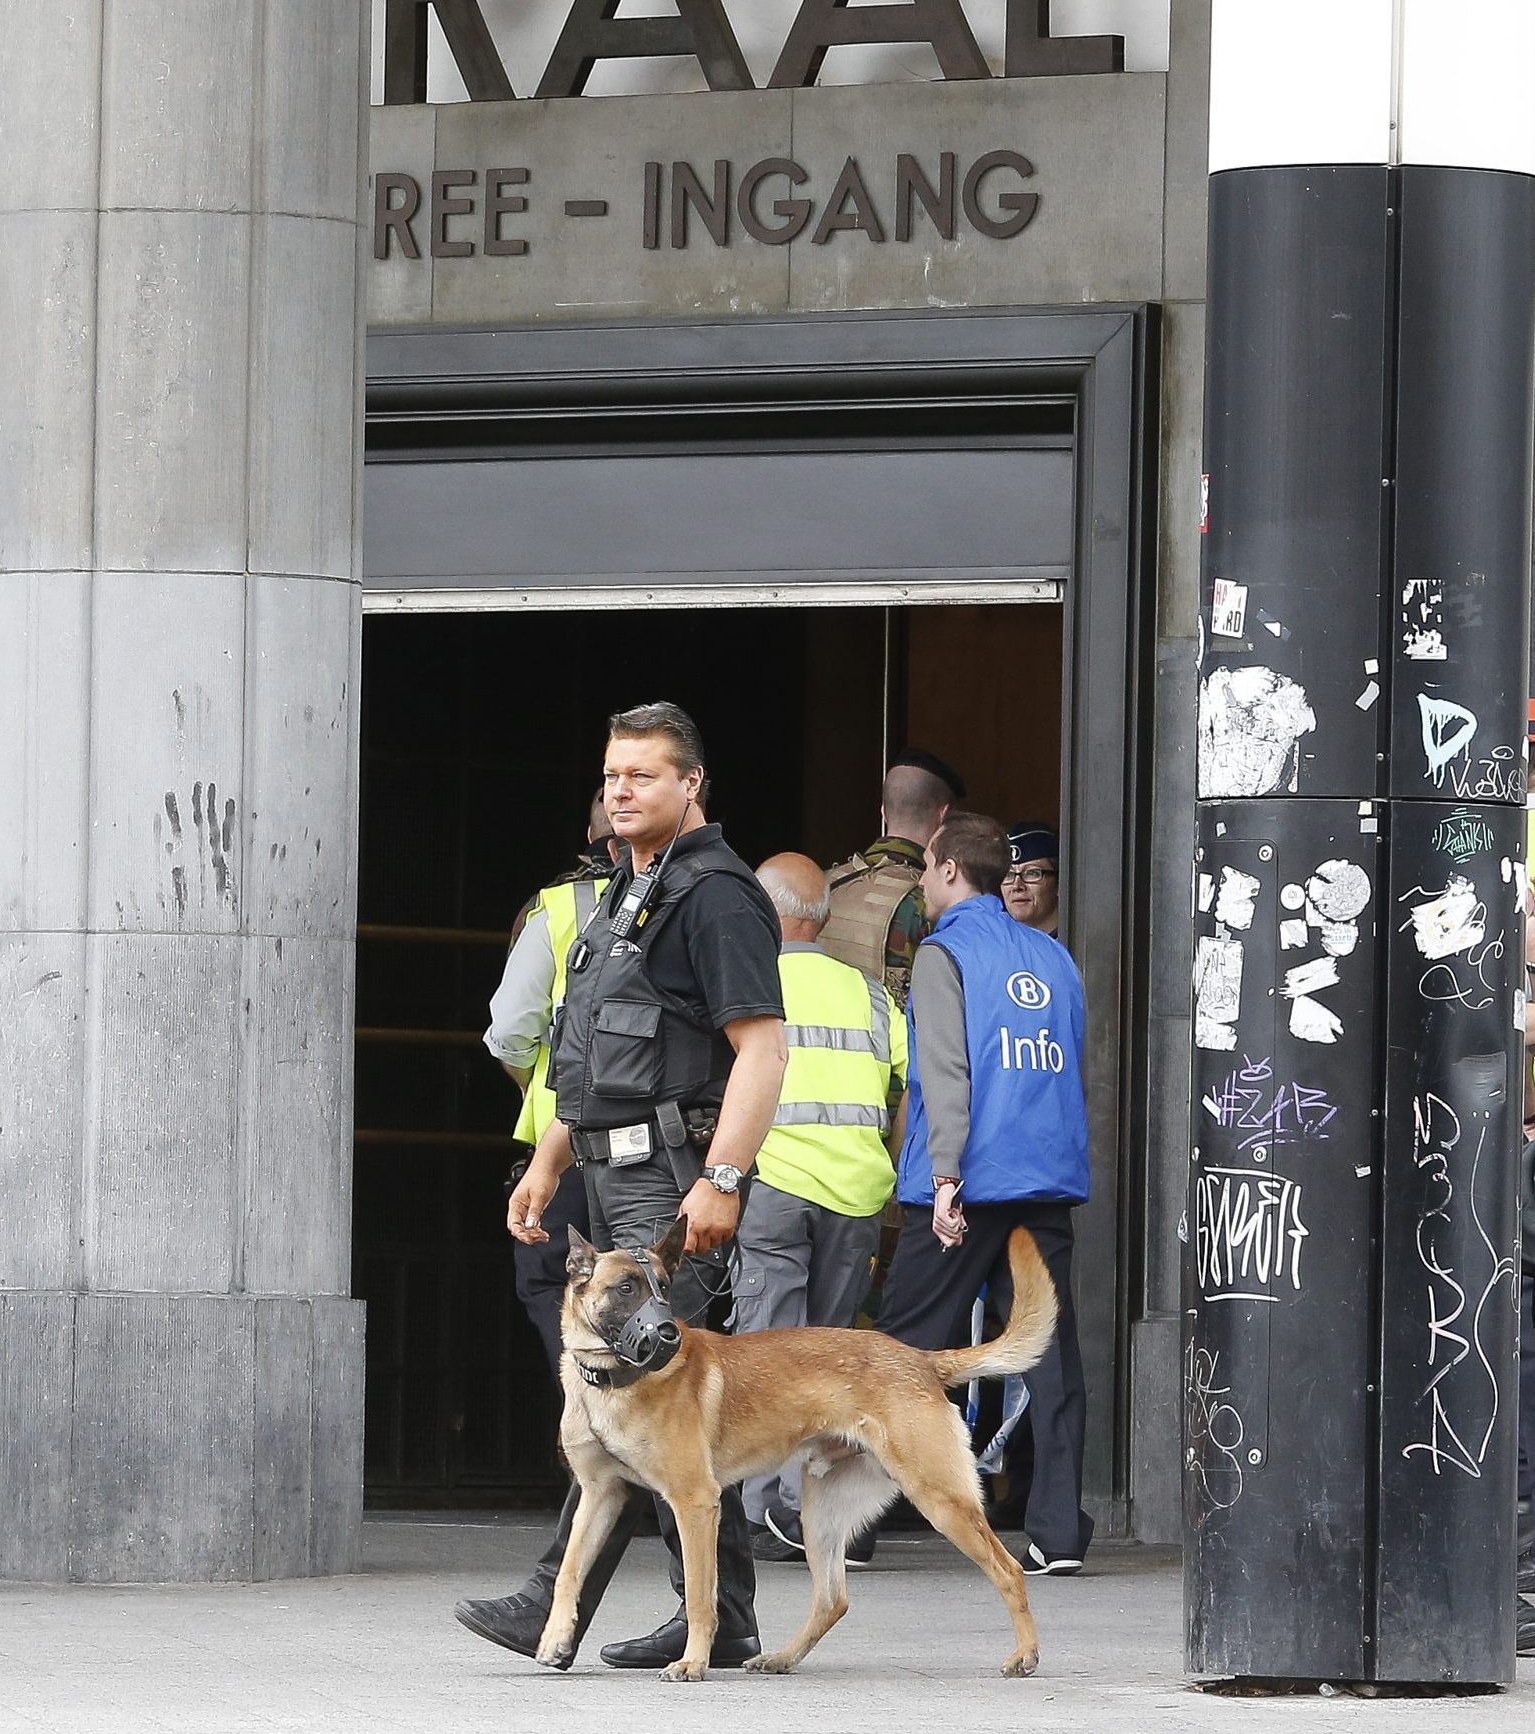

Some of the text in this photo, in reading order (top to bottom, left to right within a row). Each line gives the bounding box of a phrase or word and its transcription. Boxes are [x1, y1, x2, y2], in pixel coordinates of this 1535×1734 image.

[369, 168, 530, 259] REE
[642, 149, 1039, 249] INGANG
[999, 1025, 1064, 1074] Info
